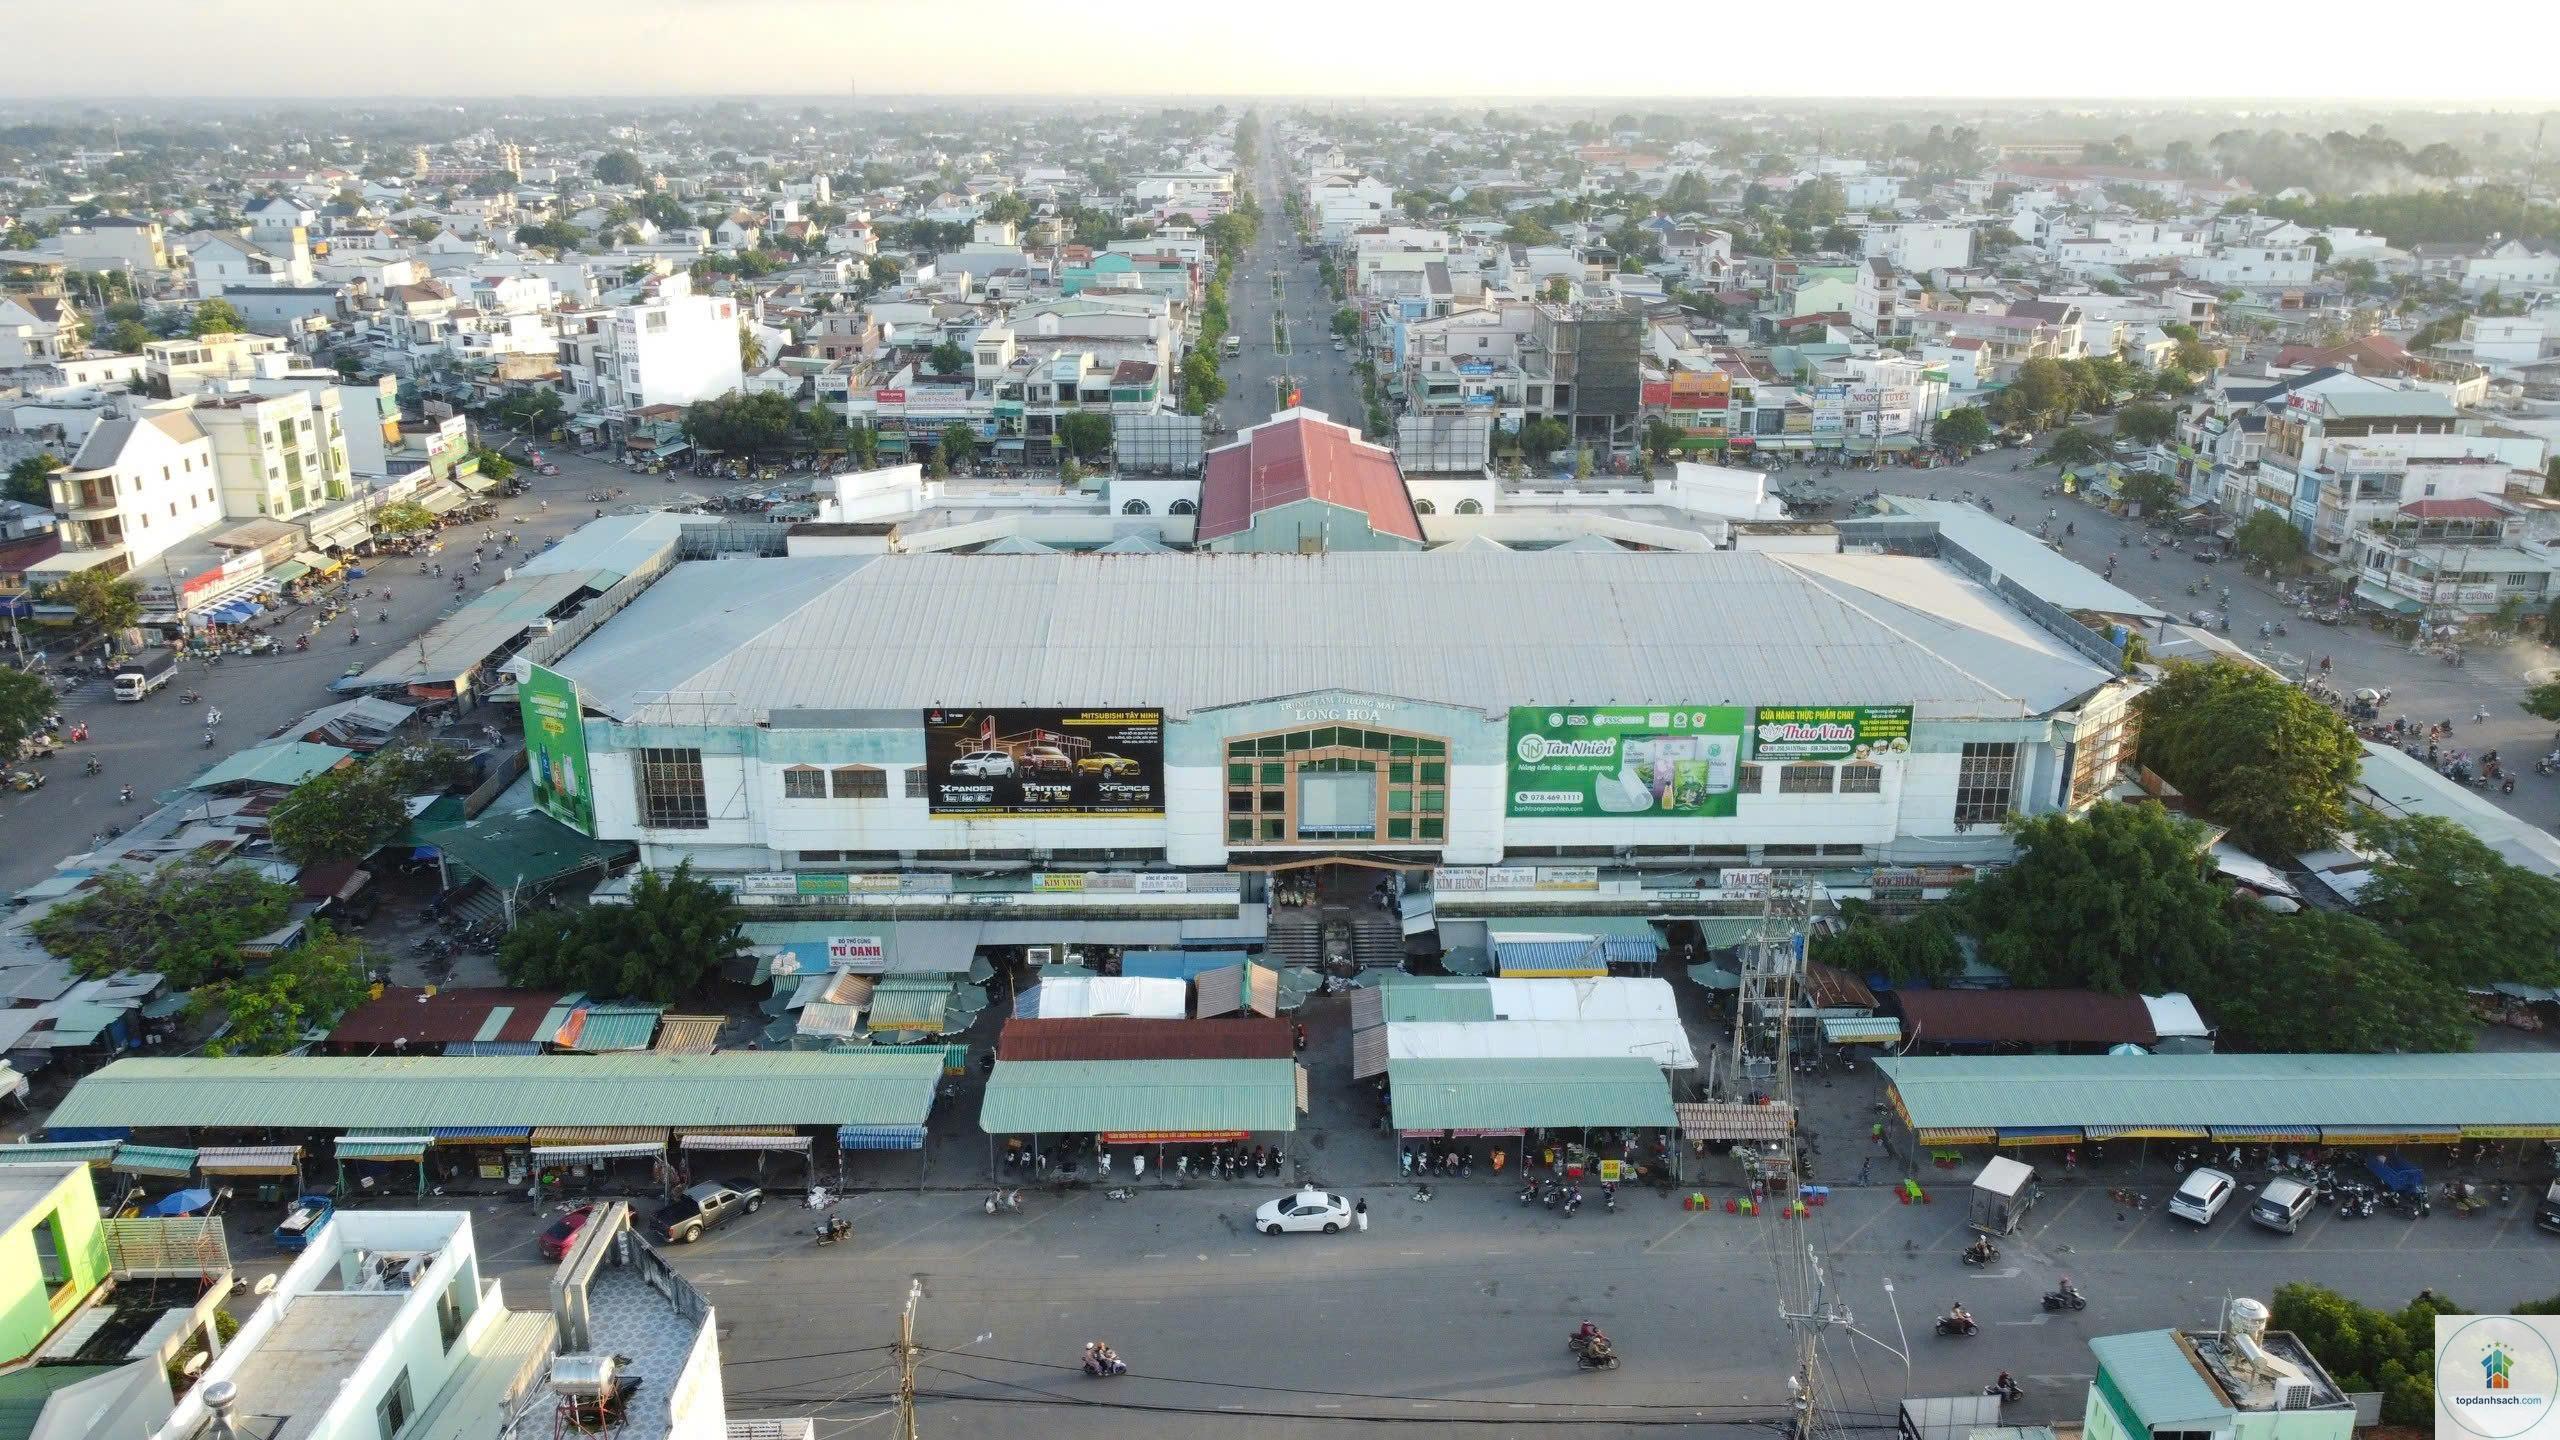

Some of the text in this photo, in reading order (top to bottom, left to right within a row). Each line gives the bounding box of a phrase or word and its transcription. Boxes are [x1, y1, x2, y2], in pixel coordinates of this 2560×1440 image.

[1125, 711, 1139, 719] TÂY
[1296, 709, 1339, 720] LONG
[1760, 708, 1855, 721] CỬA HÀNG THỰC PHẨM CHAY
[1784, 724, 1853, 739] Thảo Vinh
[1546, 742, 1611, 755] Tân Nhiên
[1044, 879, 1065, 887] KIM
[1067, 878, 1083, 887] VINH
[850, 946, 880, 956] OANH
